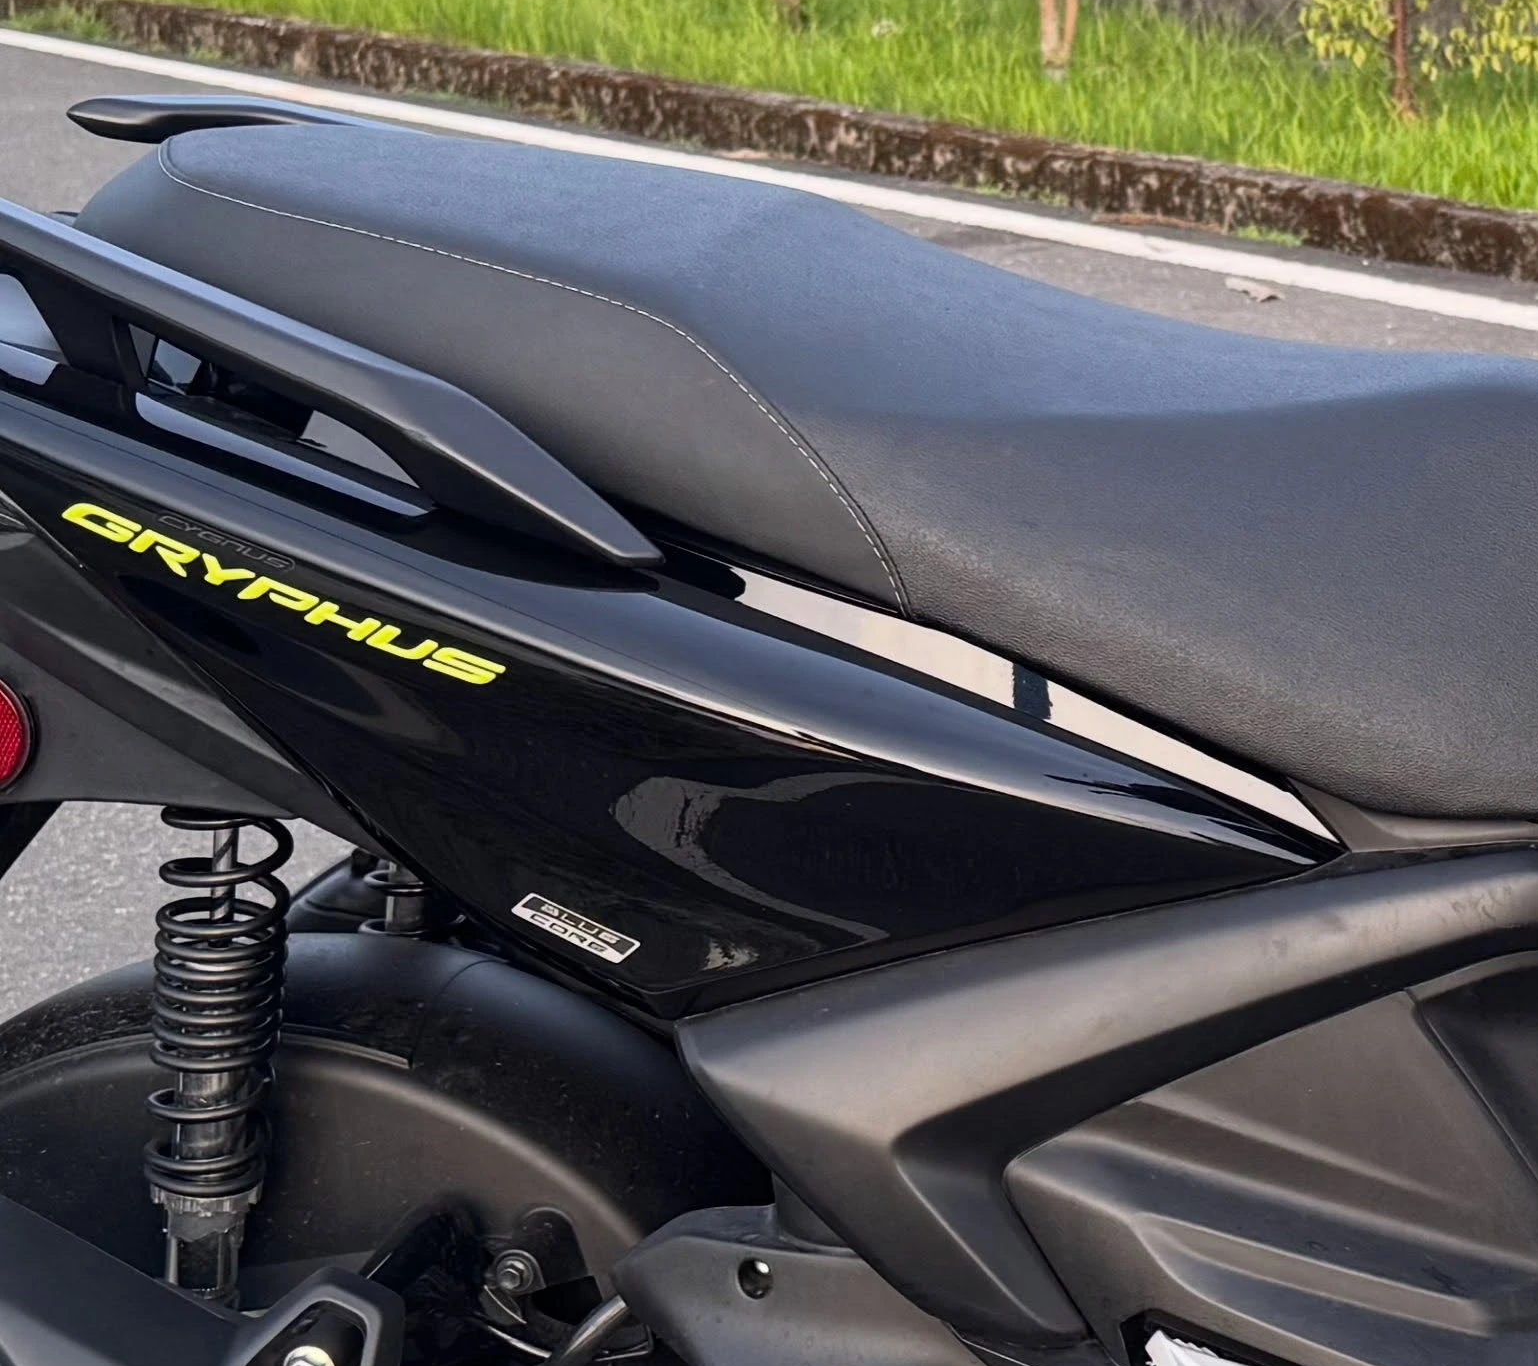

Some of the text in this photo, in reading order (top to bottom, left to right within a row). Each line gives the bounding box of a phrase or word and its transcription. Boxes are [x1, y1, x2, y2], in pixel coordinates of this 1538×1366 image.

[158, 515, 291, 569] CYGNUS
[61, 502, 506, 685] GRYPHUS
[530, 913, 608, 952] CORE
